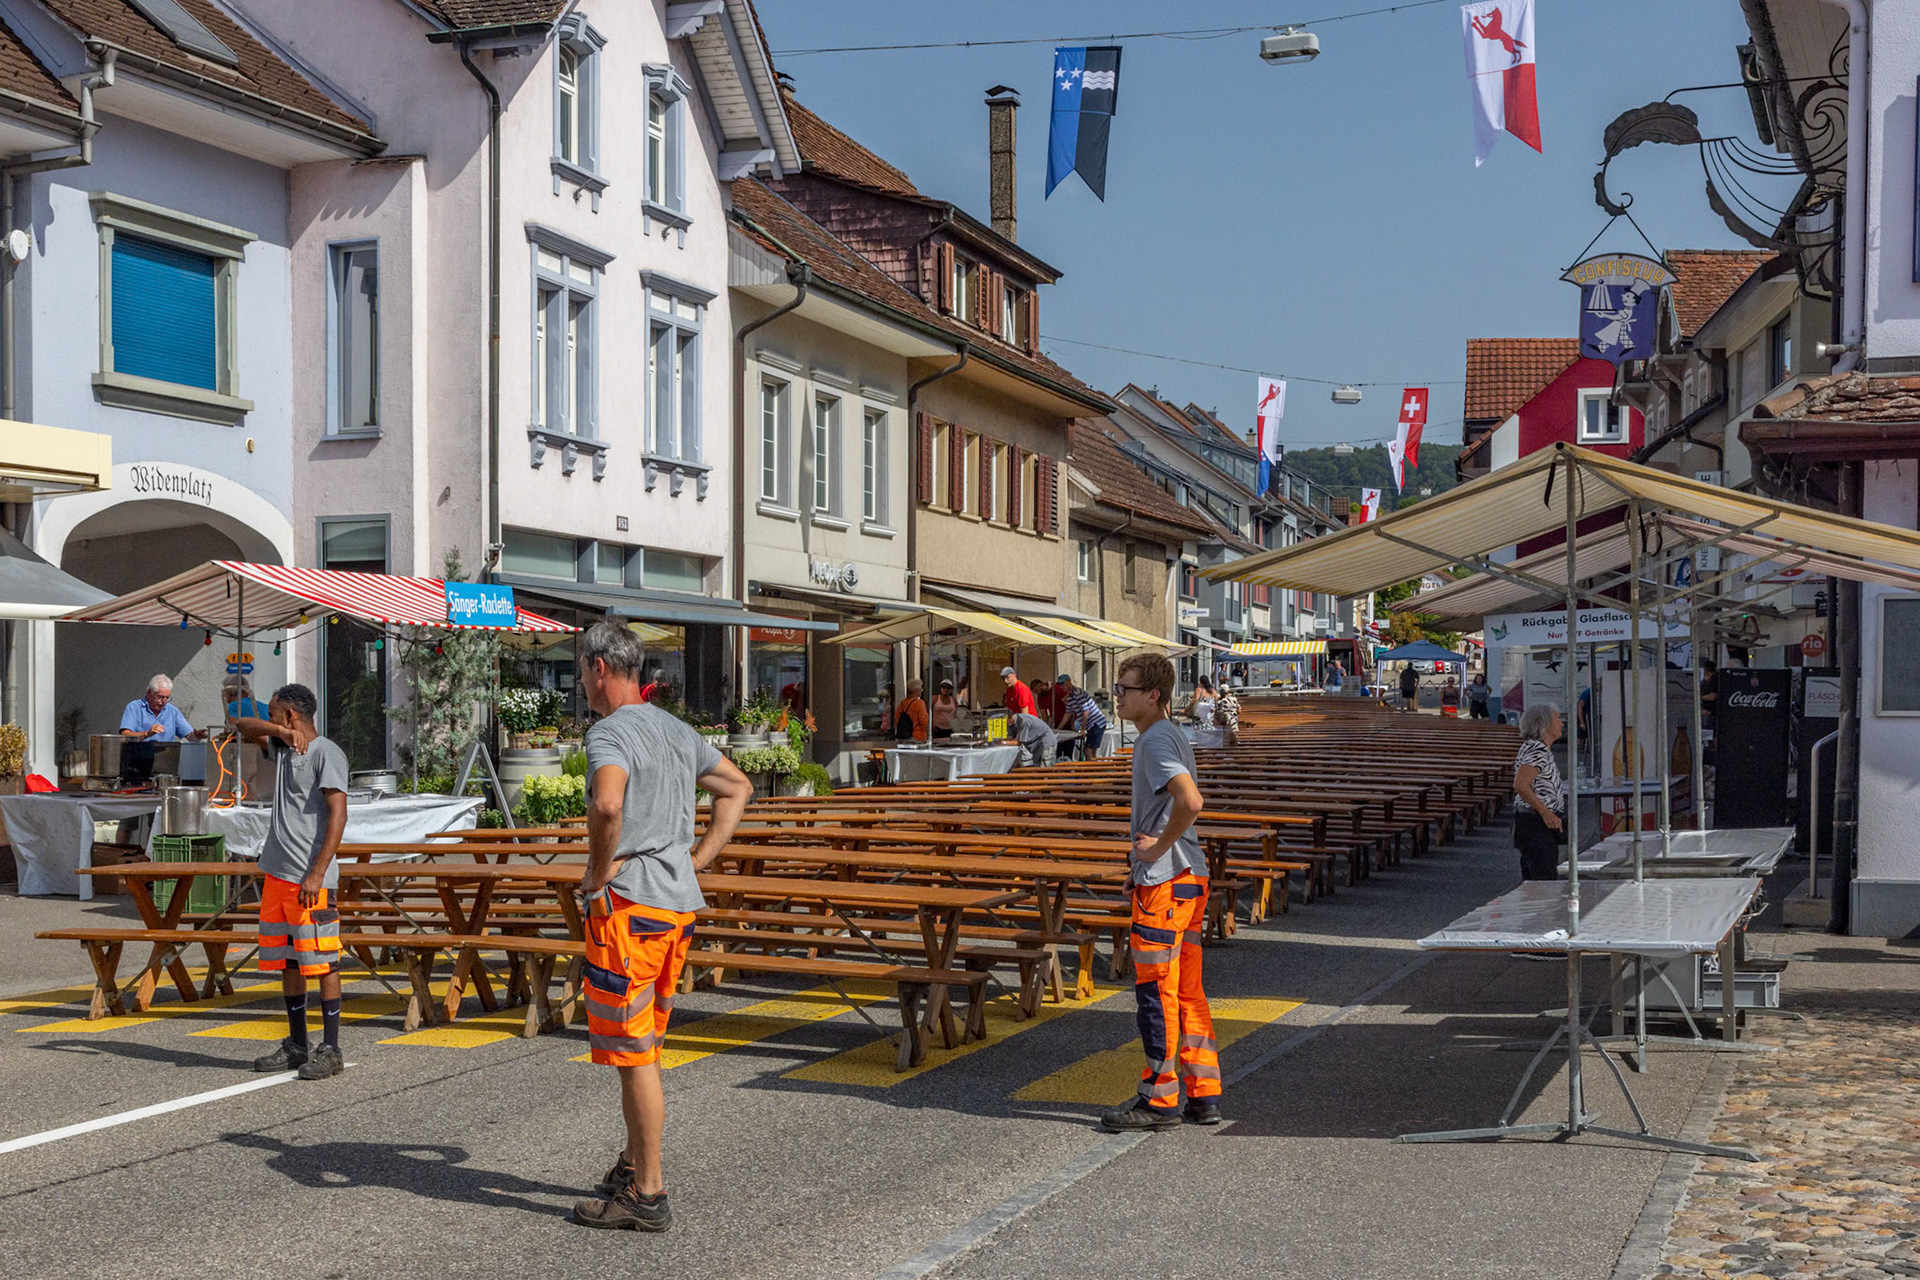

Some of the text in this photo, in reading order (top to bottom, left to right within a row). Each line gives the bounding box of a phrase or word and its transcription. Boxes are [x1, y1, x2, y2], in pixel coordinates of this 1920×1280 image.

[1573, 259, 1666, 285] CONFISEUR
[130, 465, 212, 505] Widenplatz
[448, 590, 512, 618] Sänger-Raclette
[1522, 615, 1569, 627] Rückgab
[1547, 631, 1564, 639] Nur
[1585, 628, 1624, 637] Getränke
[1728, 690, 1781, 708] Coca-Cola
